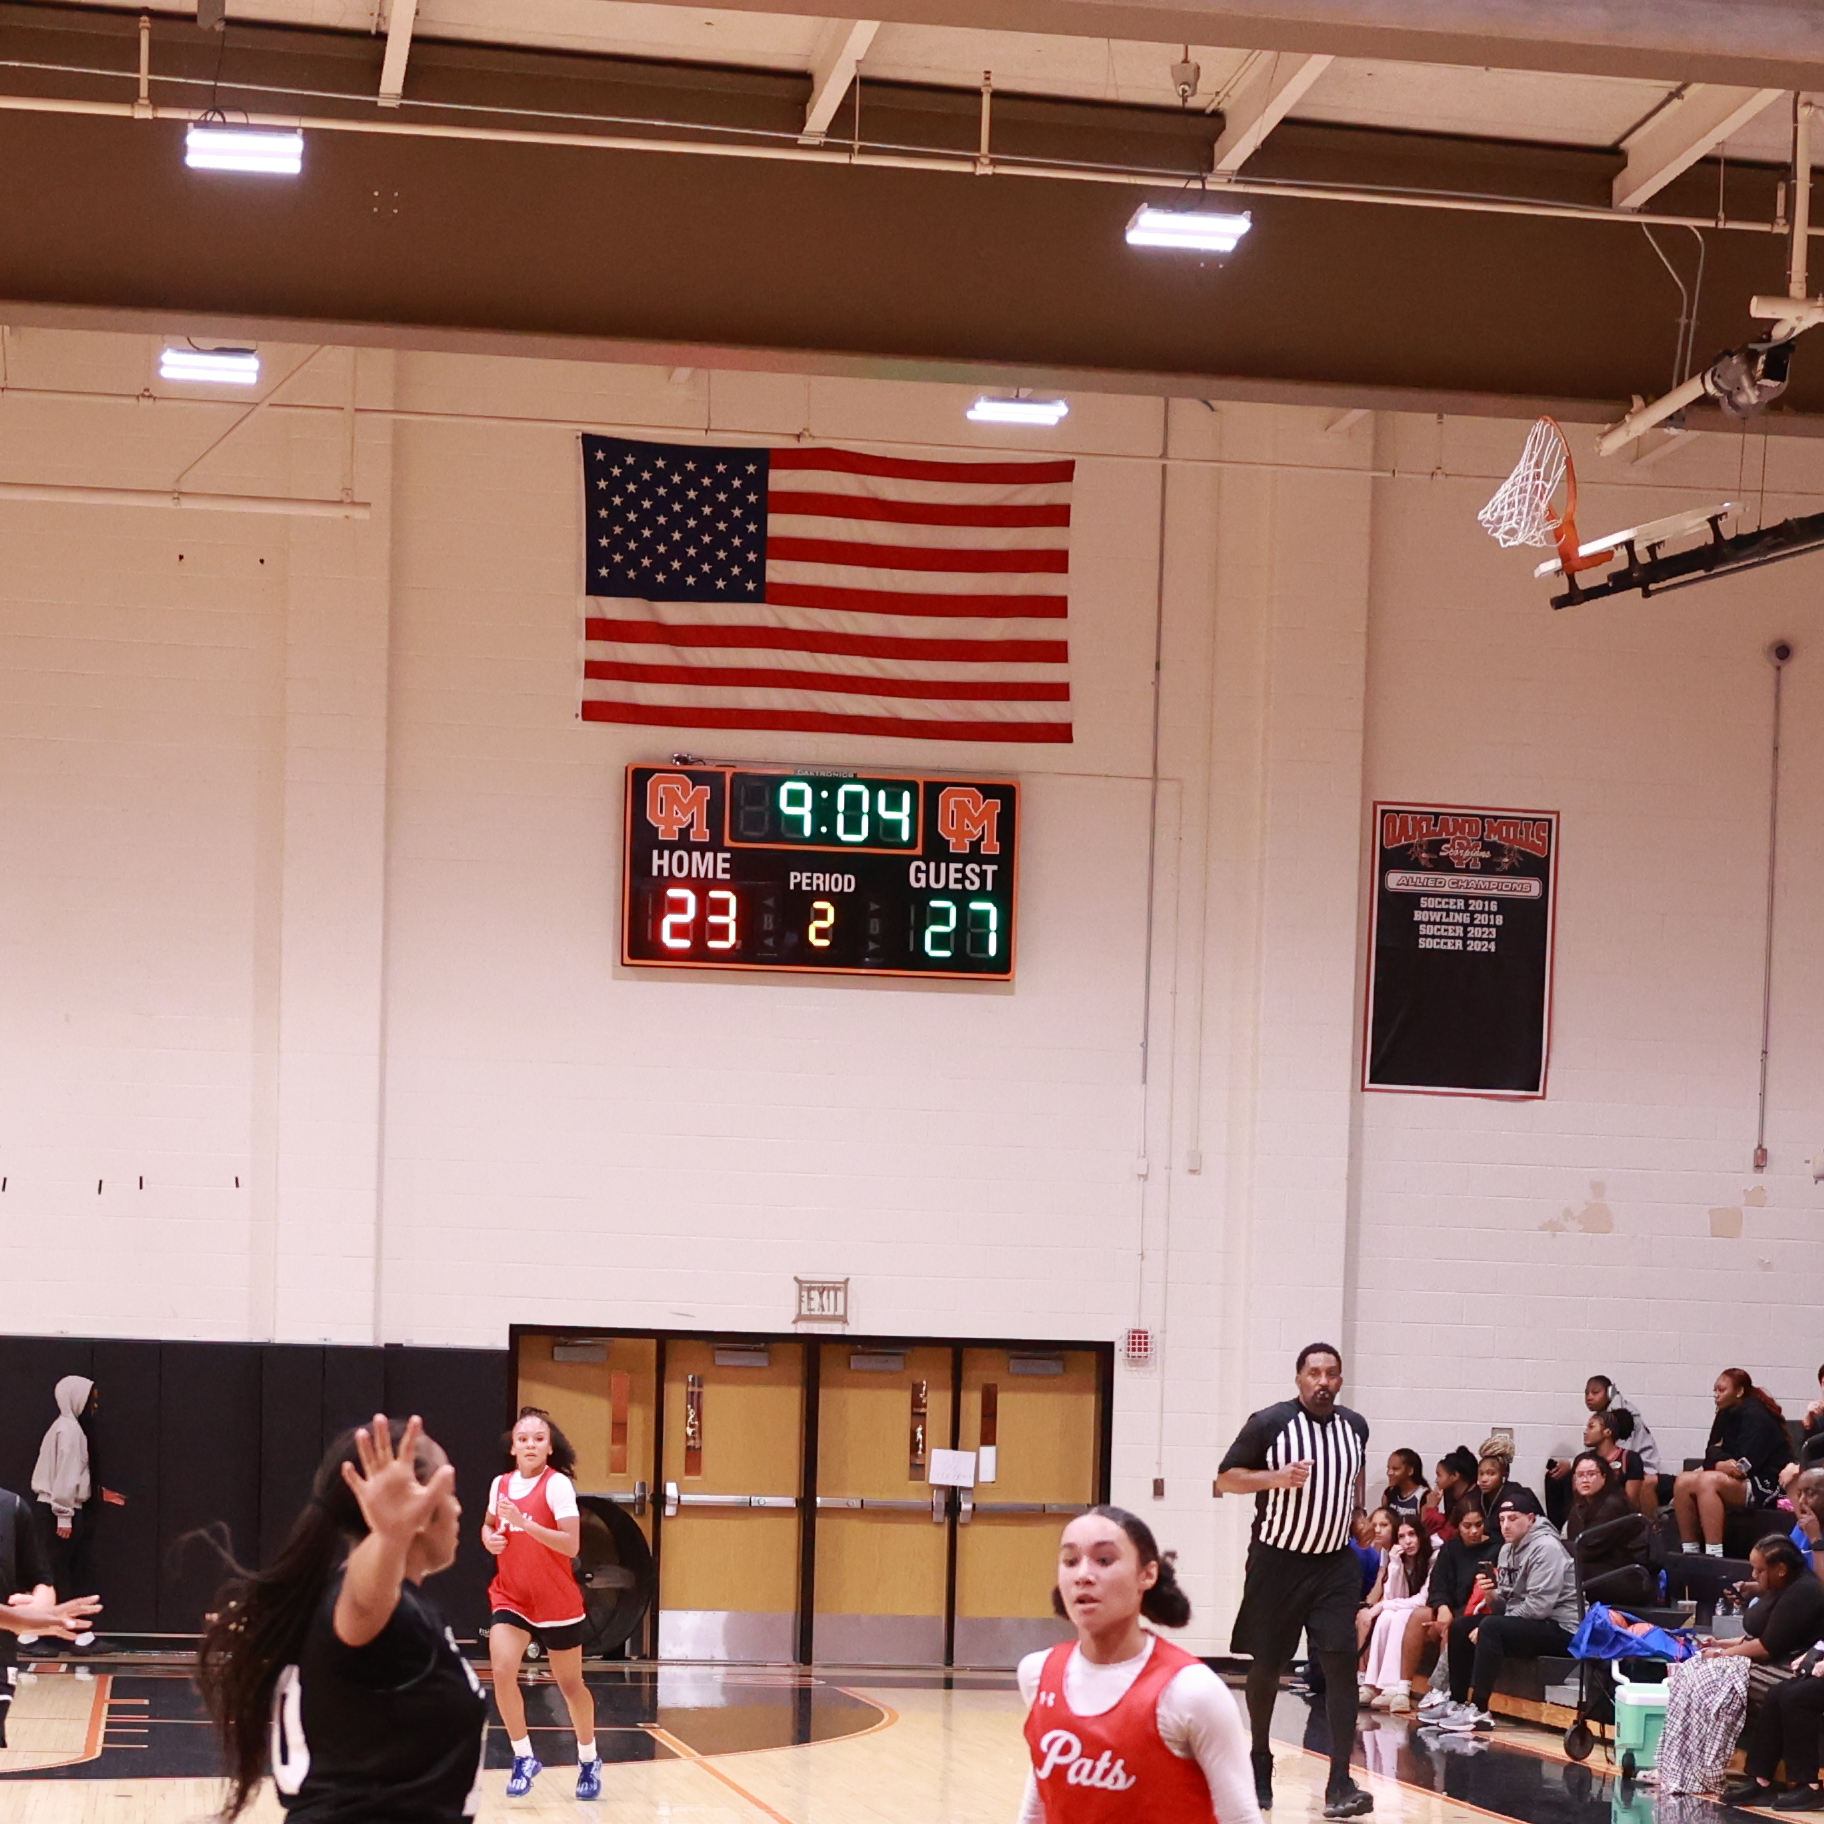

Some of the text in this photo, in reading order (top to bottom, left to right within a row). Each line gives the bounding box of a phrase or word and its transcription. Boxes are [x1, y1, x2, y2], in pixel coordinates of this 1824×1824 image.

[779, 782, 911, 842] 9:04
[1383, 813, 1548, 858] OAKLAND MILLS
[651, 850, 731, 880] HOME
[909, 861, 999, 892] GUEST
[789, 871, 856, 893] PERIOD
[1397, 875, 1532, 893] ALLIED CHAMPIONS
[661, 889, 738, 948] 23
[1413, 910, 1504, 926] BOWLING 2018
[1420, 897, 1498, 912] SOCCER 2016
[808, 901, 835, 947] 2
[924, 900, 997, 957] 27
[1419, 924, 1497, 939] SOCCER 2023
[1418, 938, 1496, 953] SOCCER 2024
[806, 1286, 842, 1312] EXIT
[1035, 1729, 1137, 1791] Pats
